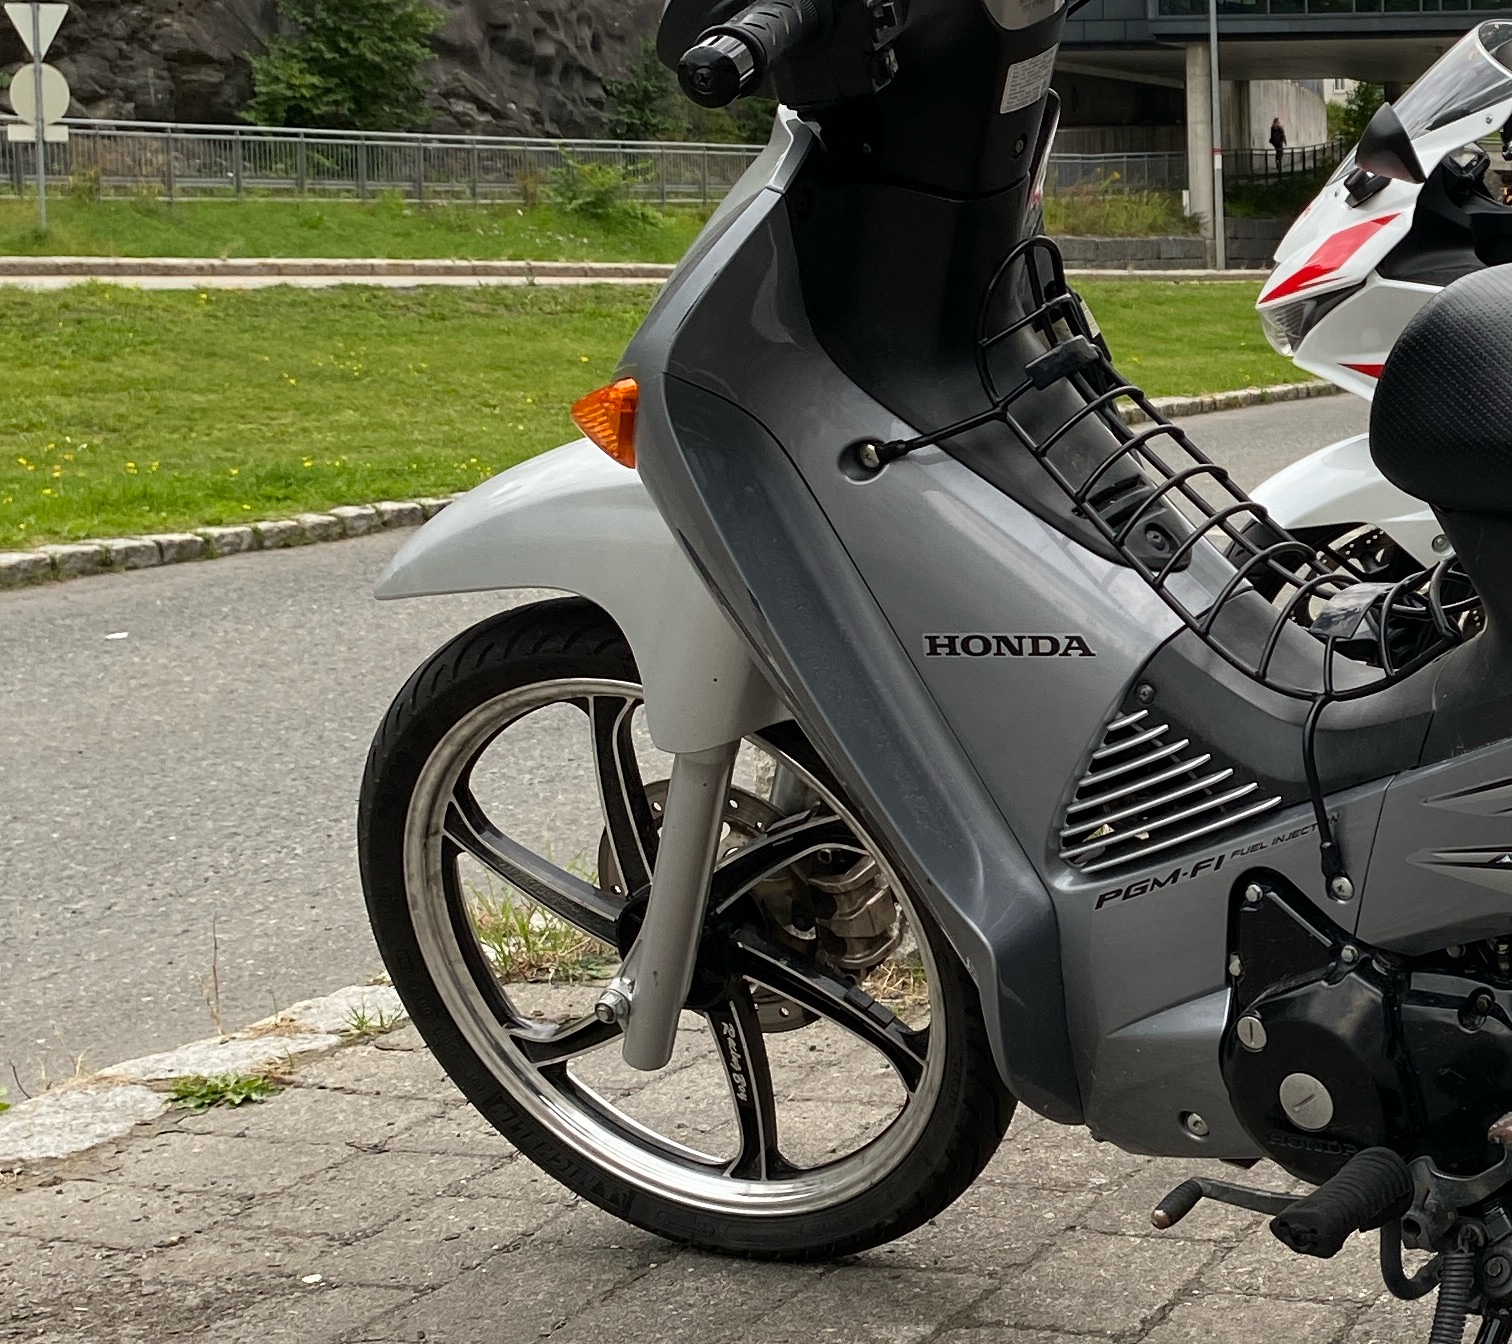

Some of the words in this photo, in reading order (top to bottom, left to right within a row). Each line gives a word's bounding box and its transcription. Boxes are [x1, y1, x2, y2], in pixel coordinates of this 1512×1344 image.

[923, 634, 1097, 657] HONDA
[1095, 854, 1225, 911] PGM-FI
[1230, 841, 1268, 859] FUEL
[1272, 813, 1340, 846] INJECTN
